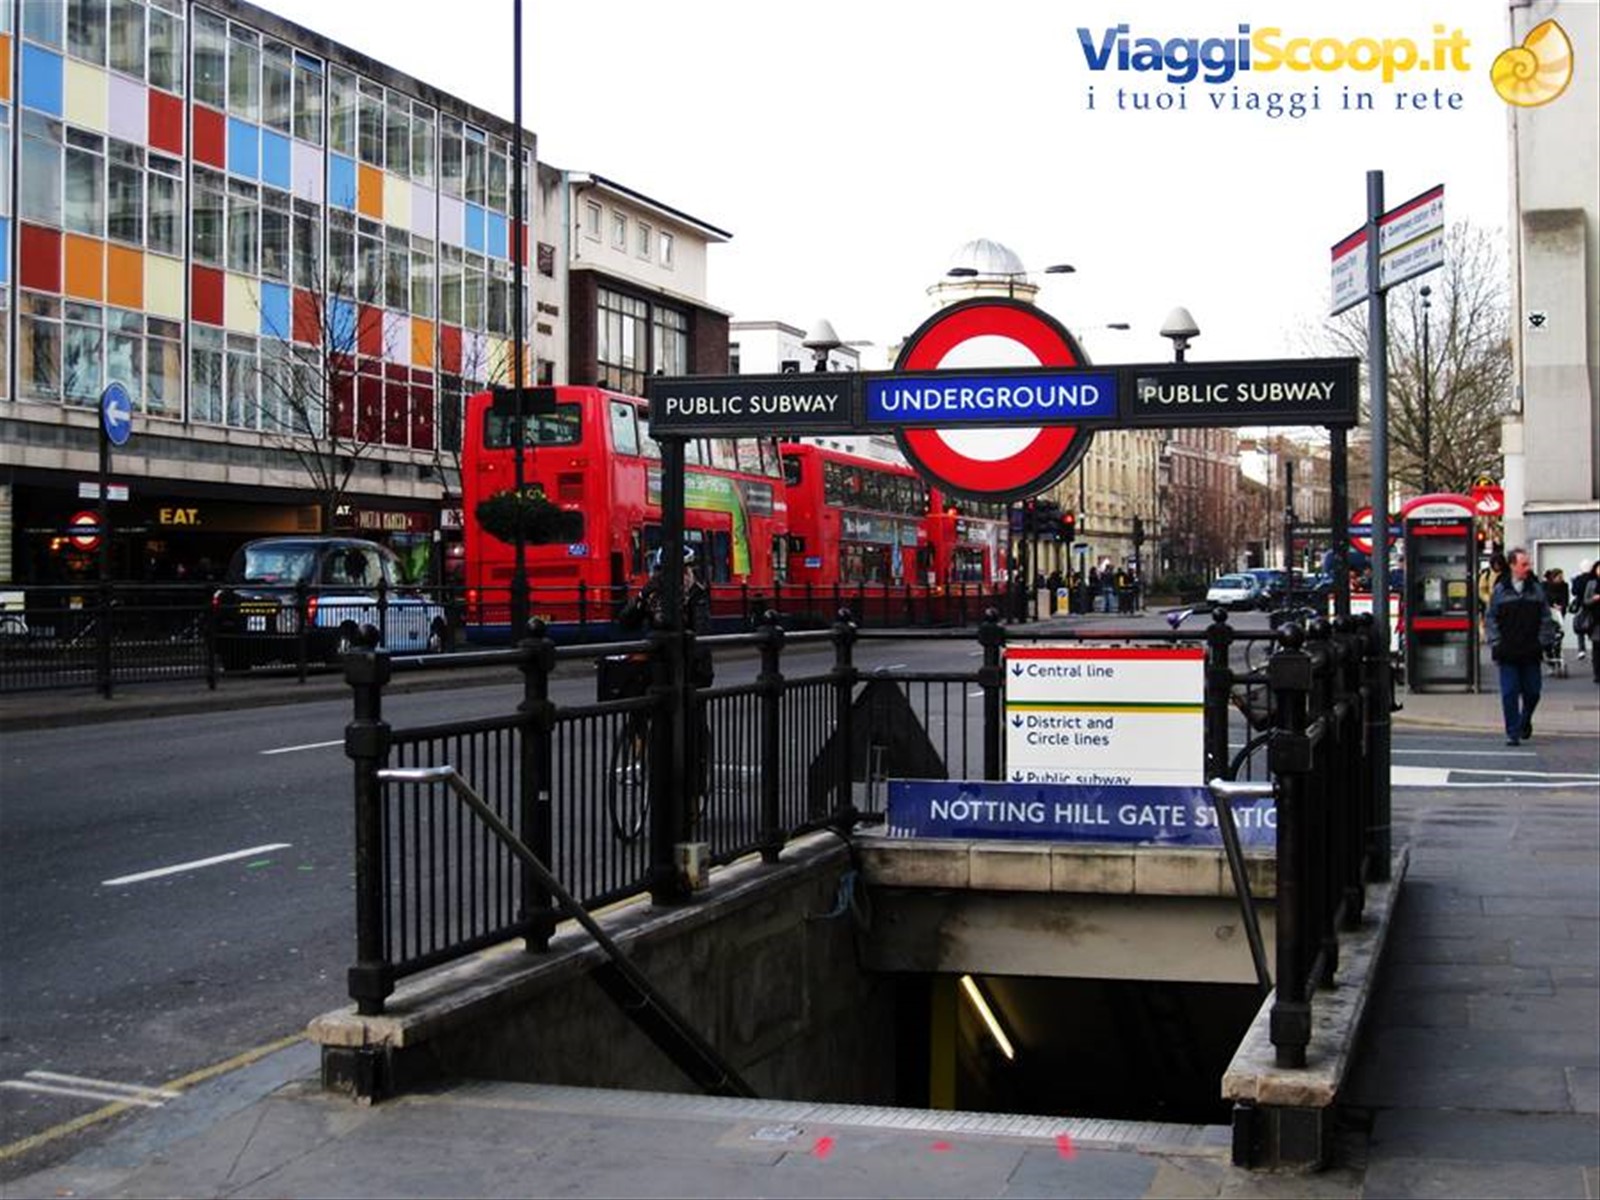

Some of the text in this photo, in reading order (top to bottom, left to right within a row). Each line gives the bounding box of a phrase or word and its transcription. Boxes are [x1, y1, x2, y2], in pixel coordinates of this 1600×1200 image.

[880, 383, 1100, 412] UNDERGROUND
[1143, 381, 1336, 404] PUBLIC SUBWAY
[666, 394, 839, 415] PUBLIC SUBWAY
[159, 507, 202, 525] EAT.
[1027, 663, 1114, 678] Central line
[1026, 715, 1114, 730] District and
[1026, 732, 1110, 746] Circle lines
[1027, 771, 1131, 786] Public subway
[930, 799, 1046, 824] NOTTING
[1054, 803, 1110, 825] HILL
[1118, 804, 1186, 827] GATE
